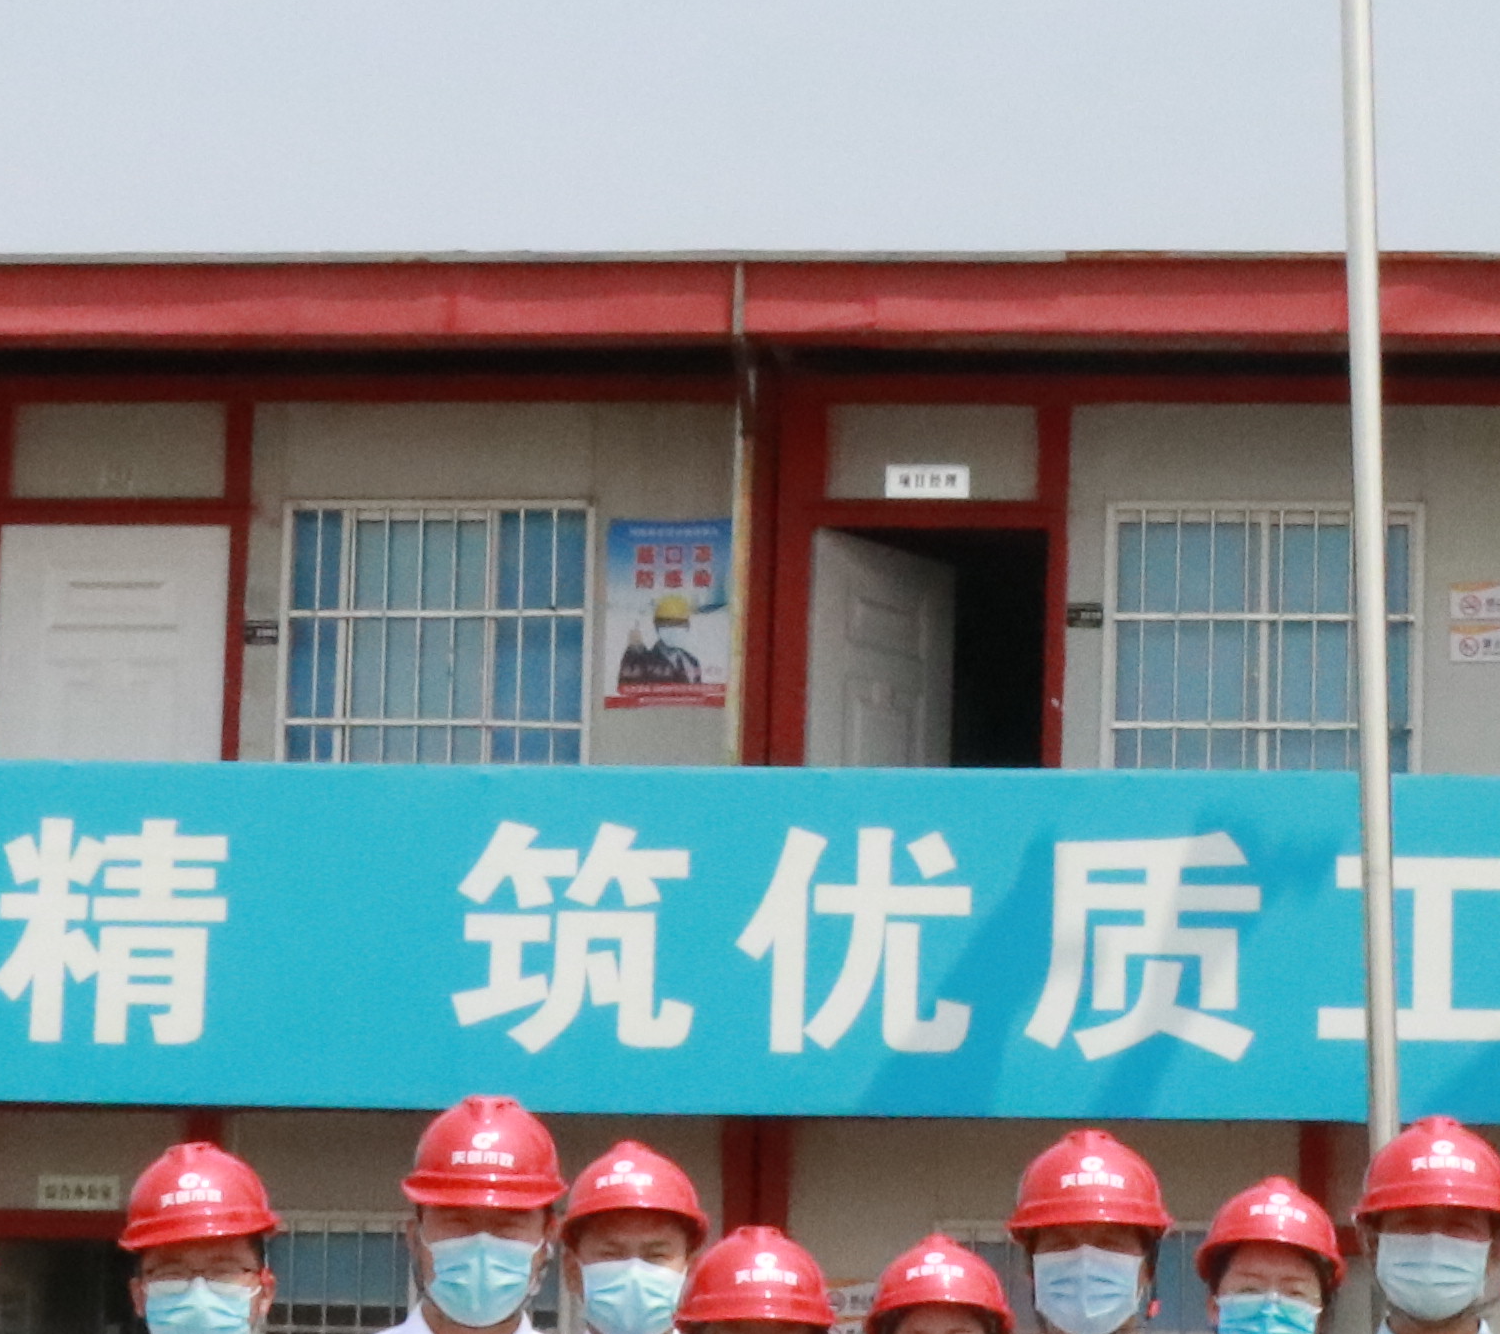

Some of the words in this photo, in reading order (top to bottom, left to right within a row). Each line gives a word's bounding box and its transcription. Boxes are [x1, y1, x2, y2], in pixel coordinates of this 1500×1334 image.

[636, 545, 712, 564] 戴口罩
[635, 570, 712, 589] 防感染
